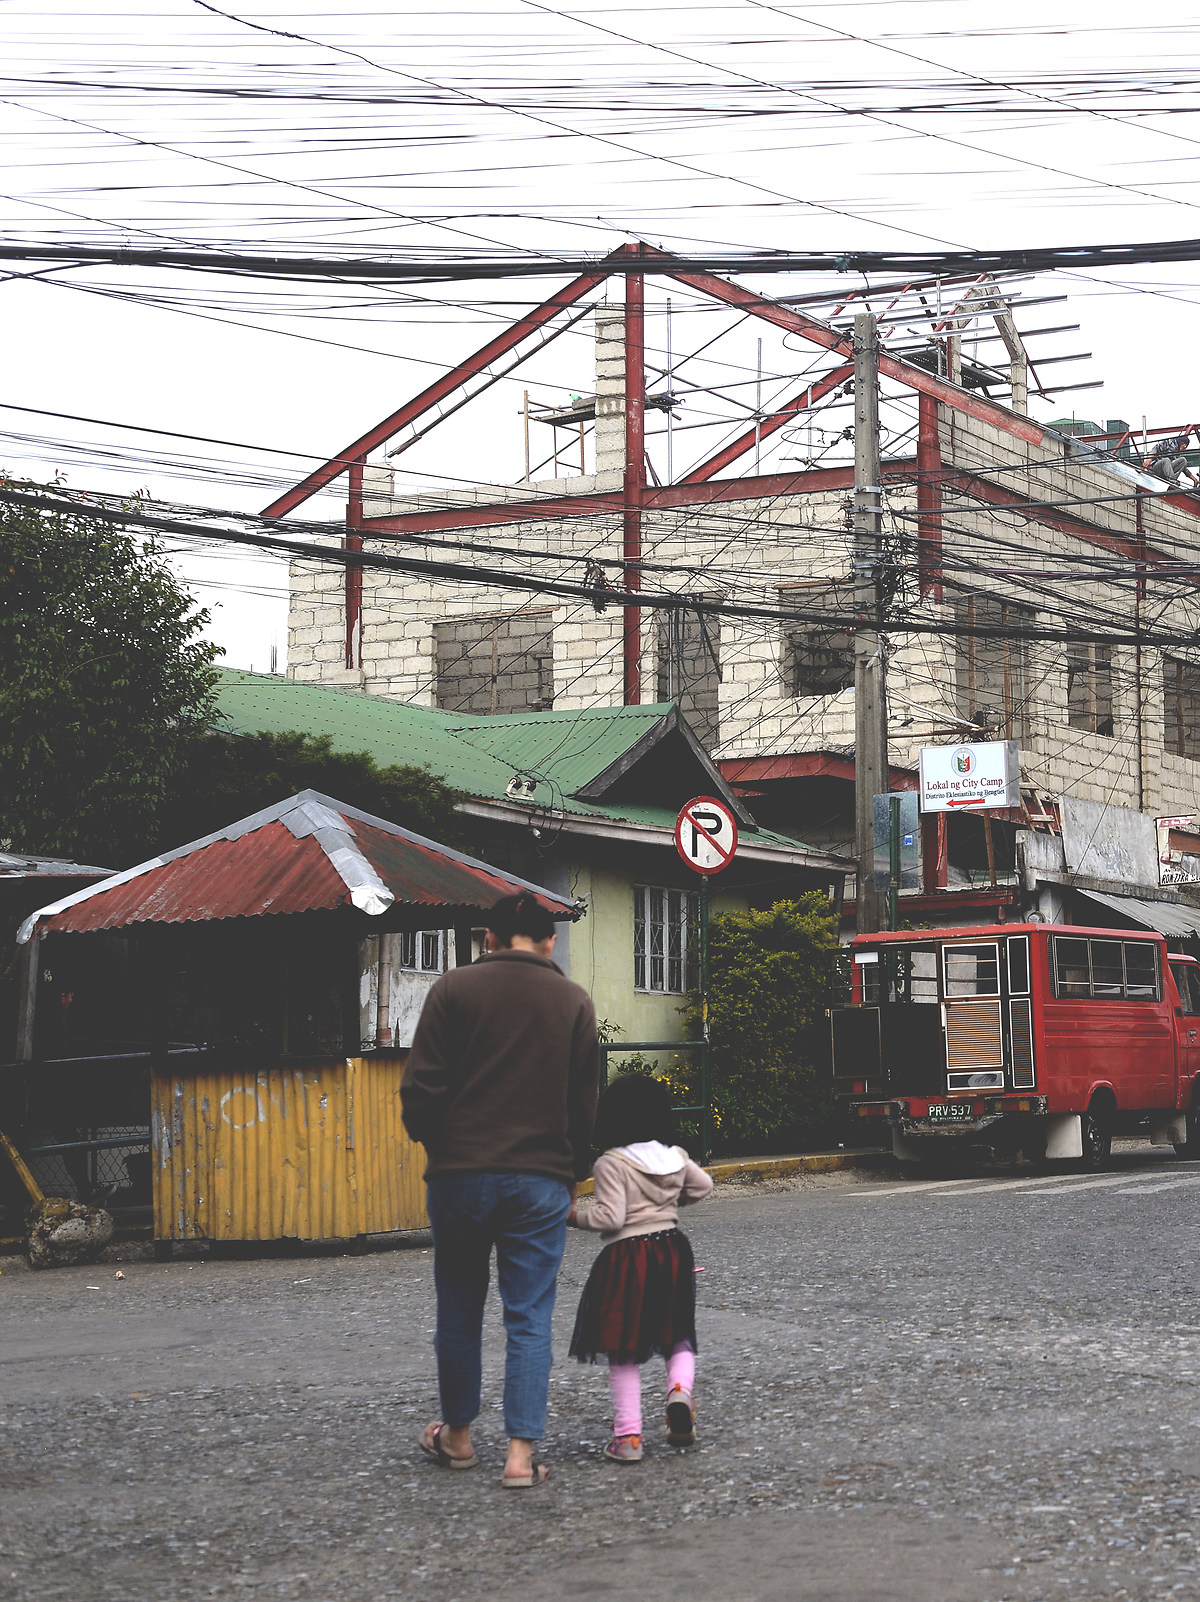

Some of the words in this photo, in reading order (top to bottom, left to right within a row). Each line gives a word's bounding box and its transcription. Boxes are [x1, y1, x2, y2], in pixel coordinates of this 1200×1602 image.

[926, 780, 949, 791] Lokal
[962, 778, 979, 789] City
[980, 777, 1004, 787] Camp
